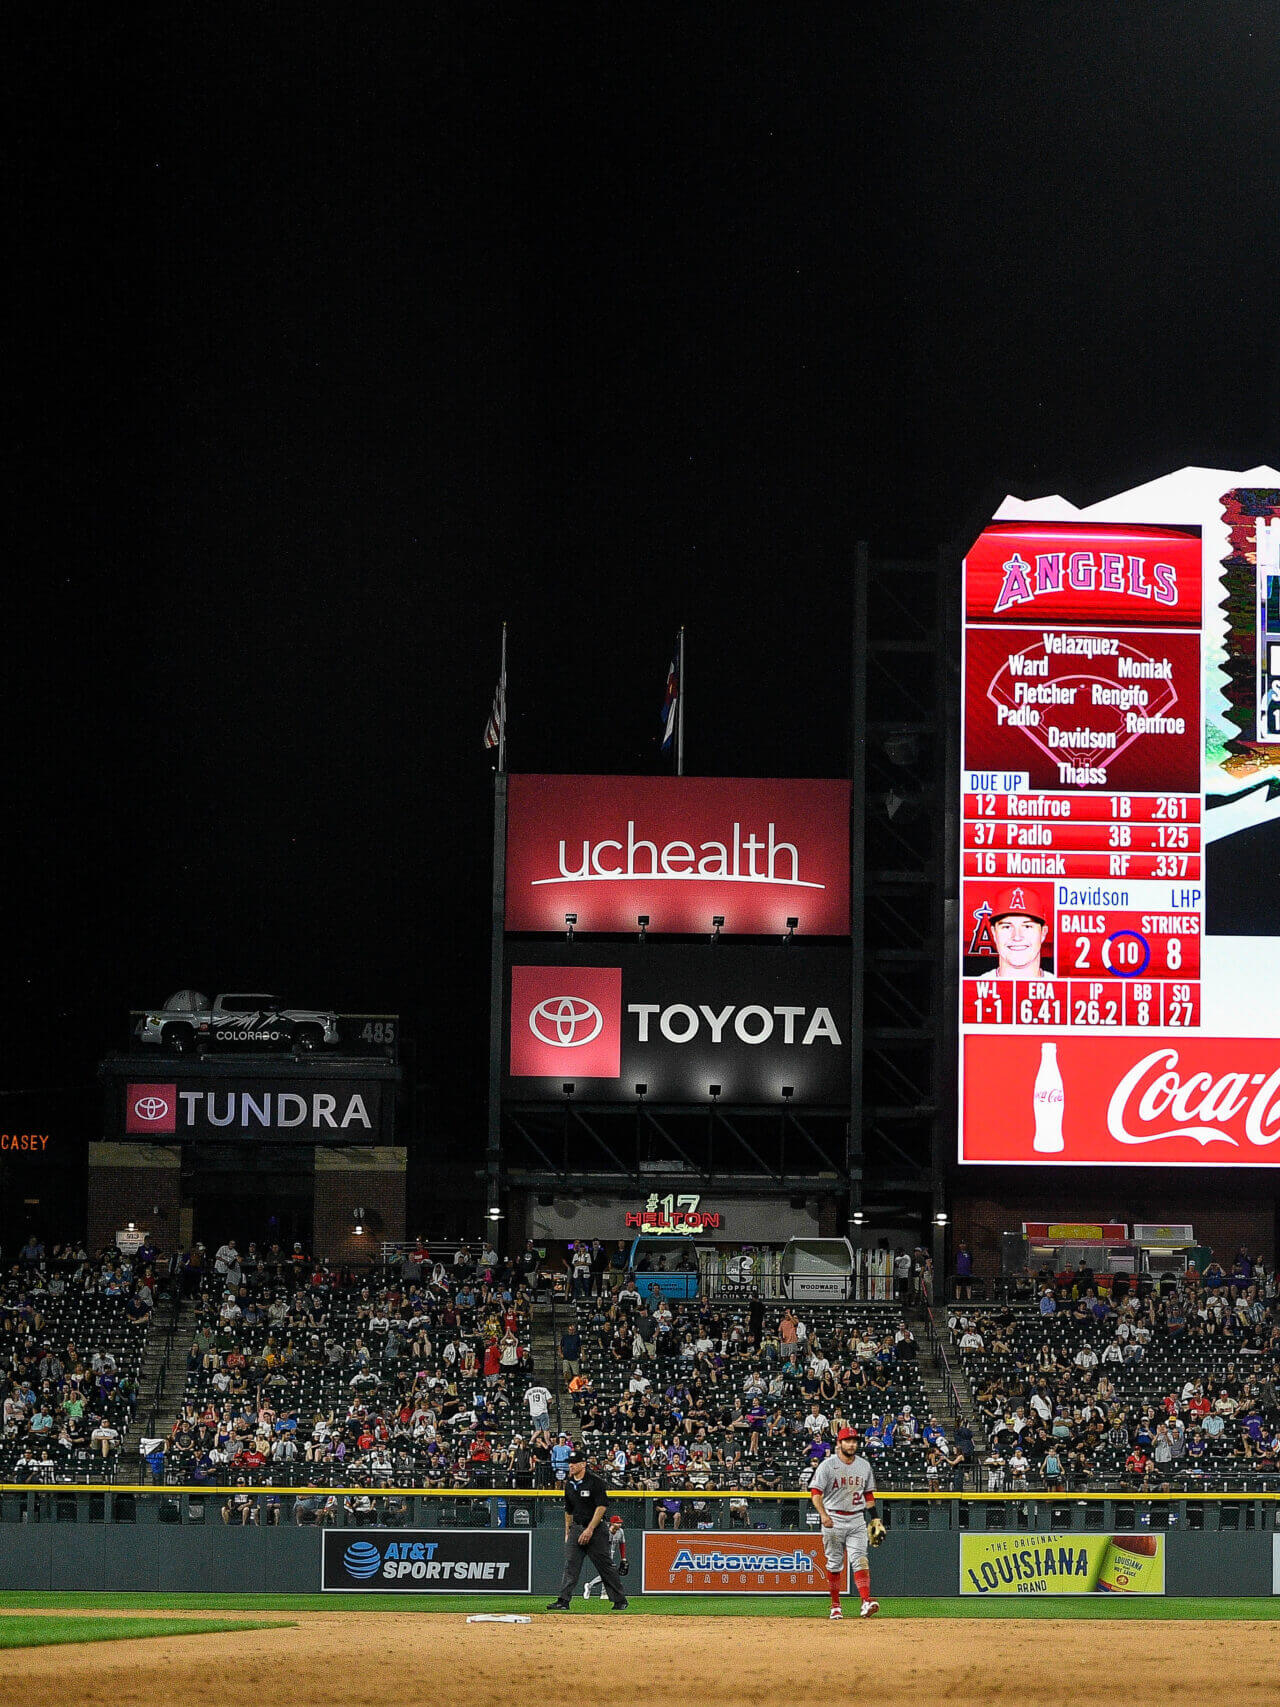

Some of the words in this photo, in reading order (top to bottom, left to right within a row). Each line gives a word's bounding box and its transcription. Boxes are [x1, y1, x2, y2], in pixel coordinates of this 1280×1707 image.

[993, 552, 1178, 613] ANGELS
[1043, 633, 1119, 659] Velazquez
[1009, 655, 1049, 676] Ward
[1118, 657, 1173, 679] Moniak
[1014, 682, 1077, 704] Fletcher
[1091, 684, 1148, 709] Rengifo
[997, 704, 1040, 727] Padlo
[1126, 712, 1186, 735] Renfroe
[1048, 727, 1117, 749] Davidson
[970, 774, 998, 791] DUE
[1003, 774, 1022, 792] UP
[1057, 762, 1107, 785] Thaiss
[975, 795, 996, 817] 12
[1006, 794, 1071, 818] Renfroe
[1110, 796, 1132, 819] 1B
[1151, 798, 1188, 820] .261
[974, 823, 996, 846] 37
[1006, 823, 1053, 847] Padlo
[1108, 825, 1132, 848] 3B
[1151, 827, 1189, 849] .125
[559, 820, 799, 881] uchealth
[975, 852, 996, 875] 16
[1006, 853, 1067, 876] Moniak
[1109, 854, 1131, 877] RF
[1151, 856, 1189, 878] .337
[1058, 886, 1129, 907] Davidson
[1171, 888, 1201, 909] LHP
[1061, 914, 1106, 934] BALLS
[1141, 915, 1199, 934] STRIKES
[1117, 942, 1139, 964] 10
[975, 982, 1001, 999] W-L
[1028, 982, 1055, 1000] ERA
[1089, 983, 1104, 1000] IP
[1133, 983, 1152, 1001] BB
[1172, 984, 1191, 1002] SO
[974, 999, 1003, 1023] 1-1
[1019, 1001, 1061, 1024] 6.41
[1074, 1001, 1118, 1025] 26.2
[1168, 1003, 1194, 1026] 27
[628, 1003, 842, 1046] TOYOTA
[179, 1091, 372, 1129] TUNDRA
[1, 1134, 50, 1152] CASEY
[625, 1211, 720, 1228] HELTON
[645, 1192, 700, 1233] #17
[720, 1284, 758, 1292] COPPER
[384, 1542, 439, 1560] AT&T
[991, 1541, 1008, 1553] THE
[1014, 1535, 1059, 1549] ORIGINAL
[382, 1561, 510, 1580] SPORTSNET
[669, 1548, 814, 1573] Autowash
[968, 1547, 1088, 1592] LOUISIANA
[669, 1573, 814, 1585] FRANCHISE
[1017, 1579, 1047, 1592] BRAND
